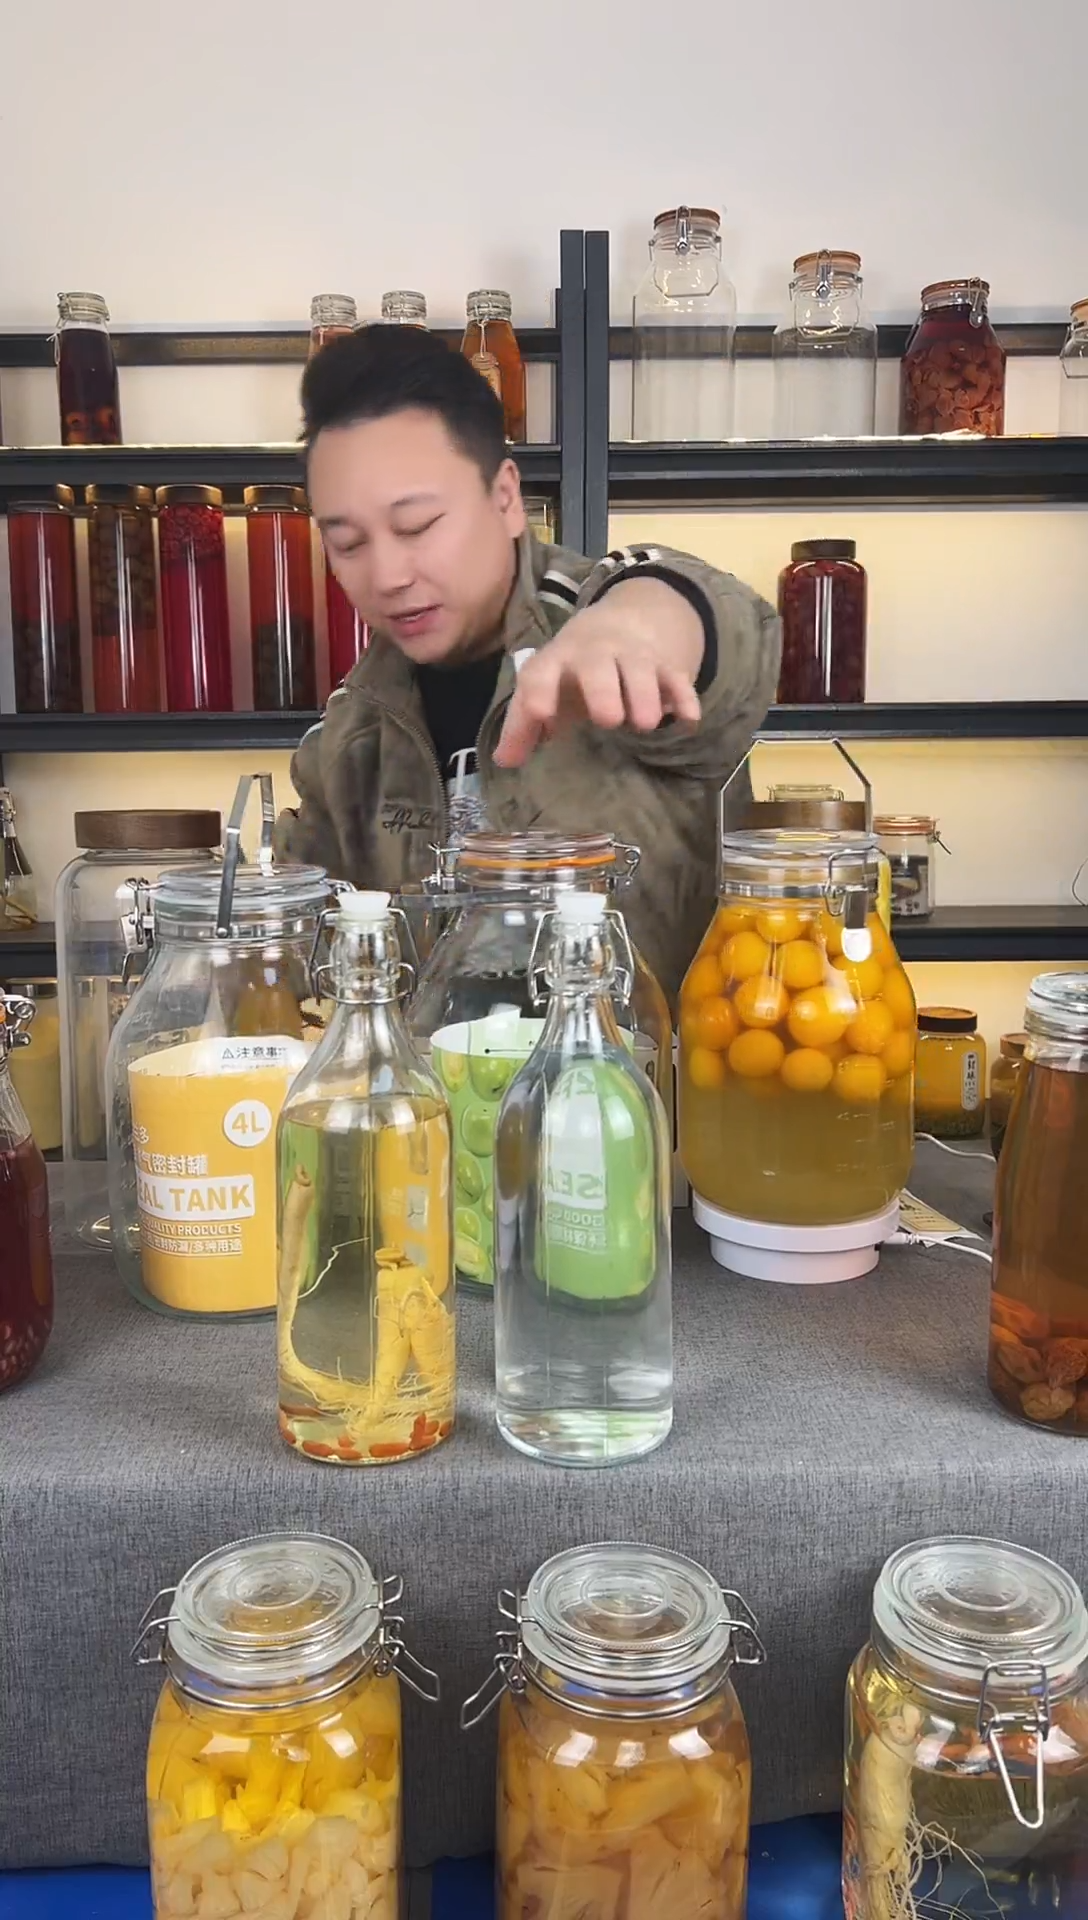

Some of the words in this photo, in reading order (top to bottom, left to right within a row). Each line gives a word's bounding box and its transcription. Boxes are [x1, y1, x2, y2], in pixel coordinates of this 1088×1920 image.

[231, 1111, 265, 1135] 4L
[168, 1183, 252, 1213] TANK
[177, 1223, 242, 1235] PRODUCTS
